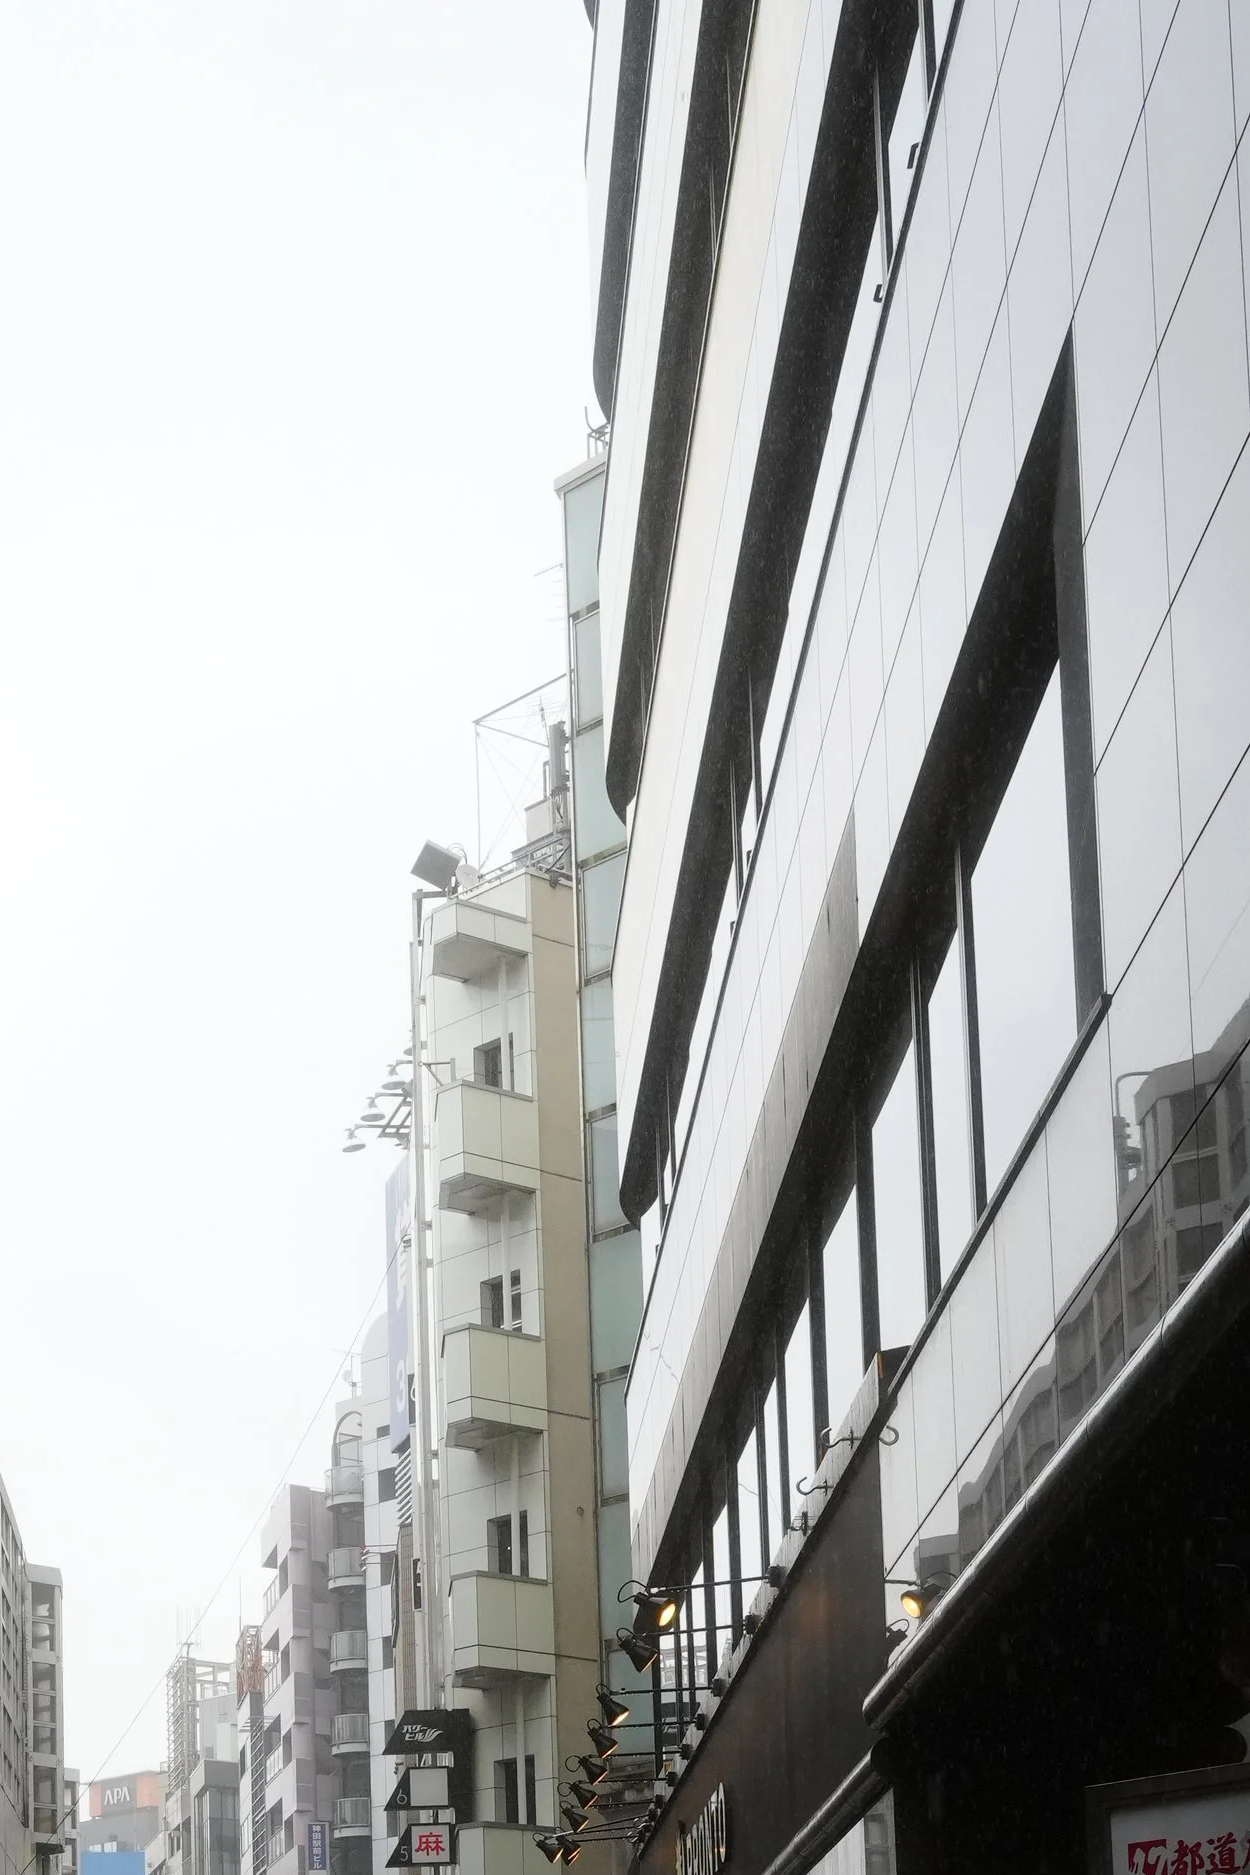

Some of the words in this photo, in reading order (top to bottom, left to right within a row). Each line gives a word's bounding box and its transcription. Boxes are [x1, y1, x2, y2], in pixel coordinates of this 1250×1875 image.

[104, 1786, 130, 1805] APA
[398, 1787, 407, 1805] 6
[415, 1832, 445, 1857] 麻
[399, 1846, 409, 1862] 5
